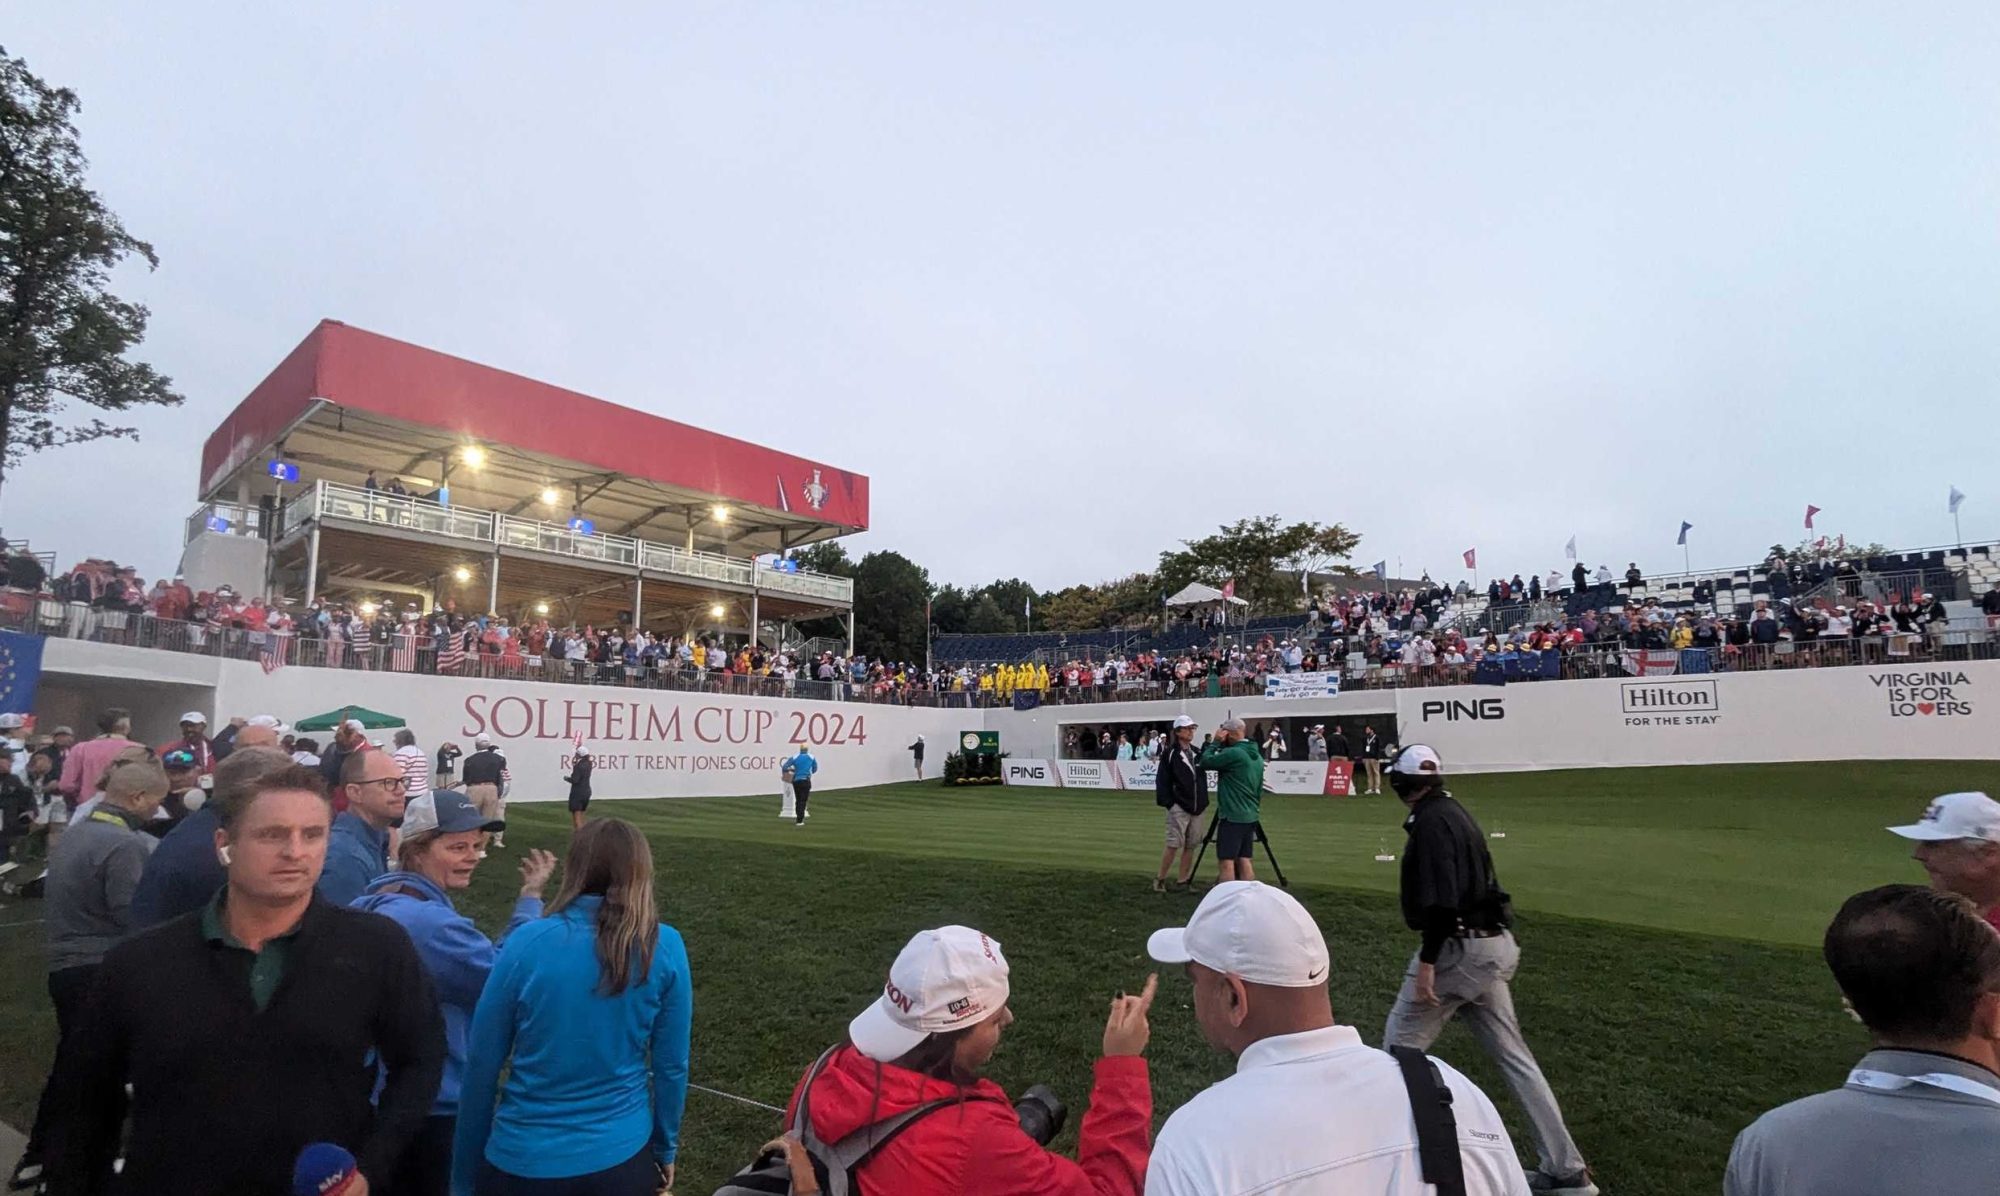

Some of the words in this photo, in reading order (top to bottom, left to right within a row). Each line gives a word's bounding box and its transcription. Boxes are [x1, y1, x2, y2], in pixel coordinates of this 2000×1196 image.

[1868, 671, 1971, 687] VIRGINIA
[1629, 687, 1710, 707] Hilton
[1889, 688, 1906, 702] IS
[1910, 686, 1958, 701] FOR
[1422, 698, 1505, 722] PING
[462, 694, 684, 742] SOLHEIM
[694, 706, 773, 744] CUP
[788, 711, 868, 746] 2024
[1625, 717, 1650, 726] FOR
[1654, 716, 1681, 725] THE
[1685, 715, 1717, 724] STAY
[560, 755, 629, 770] RBERT
[637, 755, 687, 770] TRENT
[691, 755, 736, 774] JONES
[740, 756, 776, 770] GOLF
[1010, 766, 1045, 779] PING
[1070, 765, 1098, 776] Hilton
[1334, 766, 1342, 775] 1
